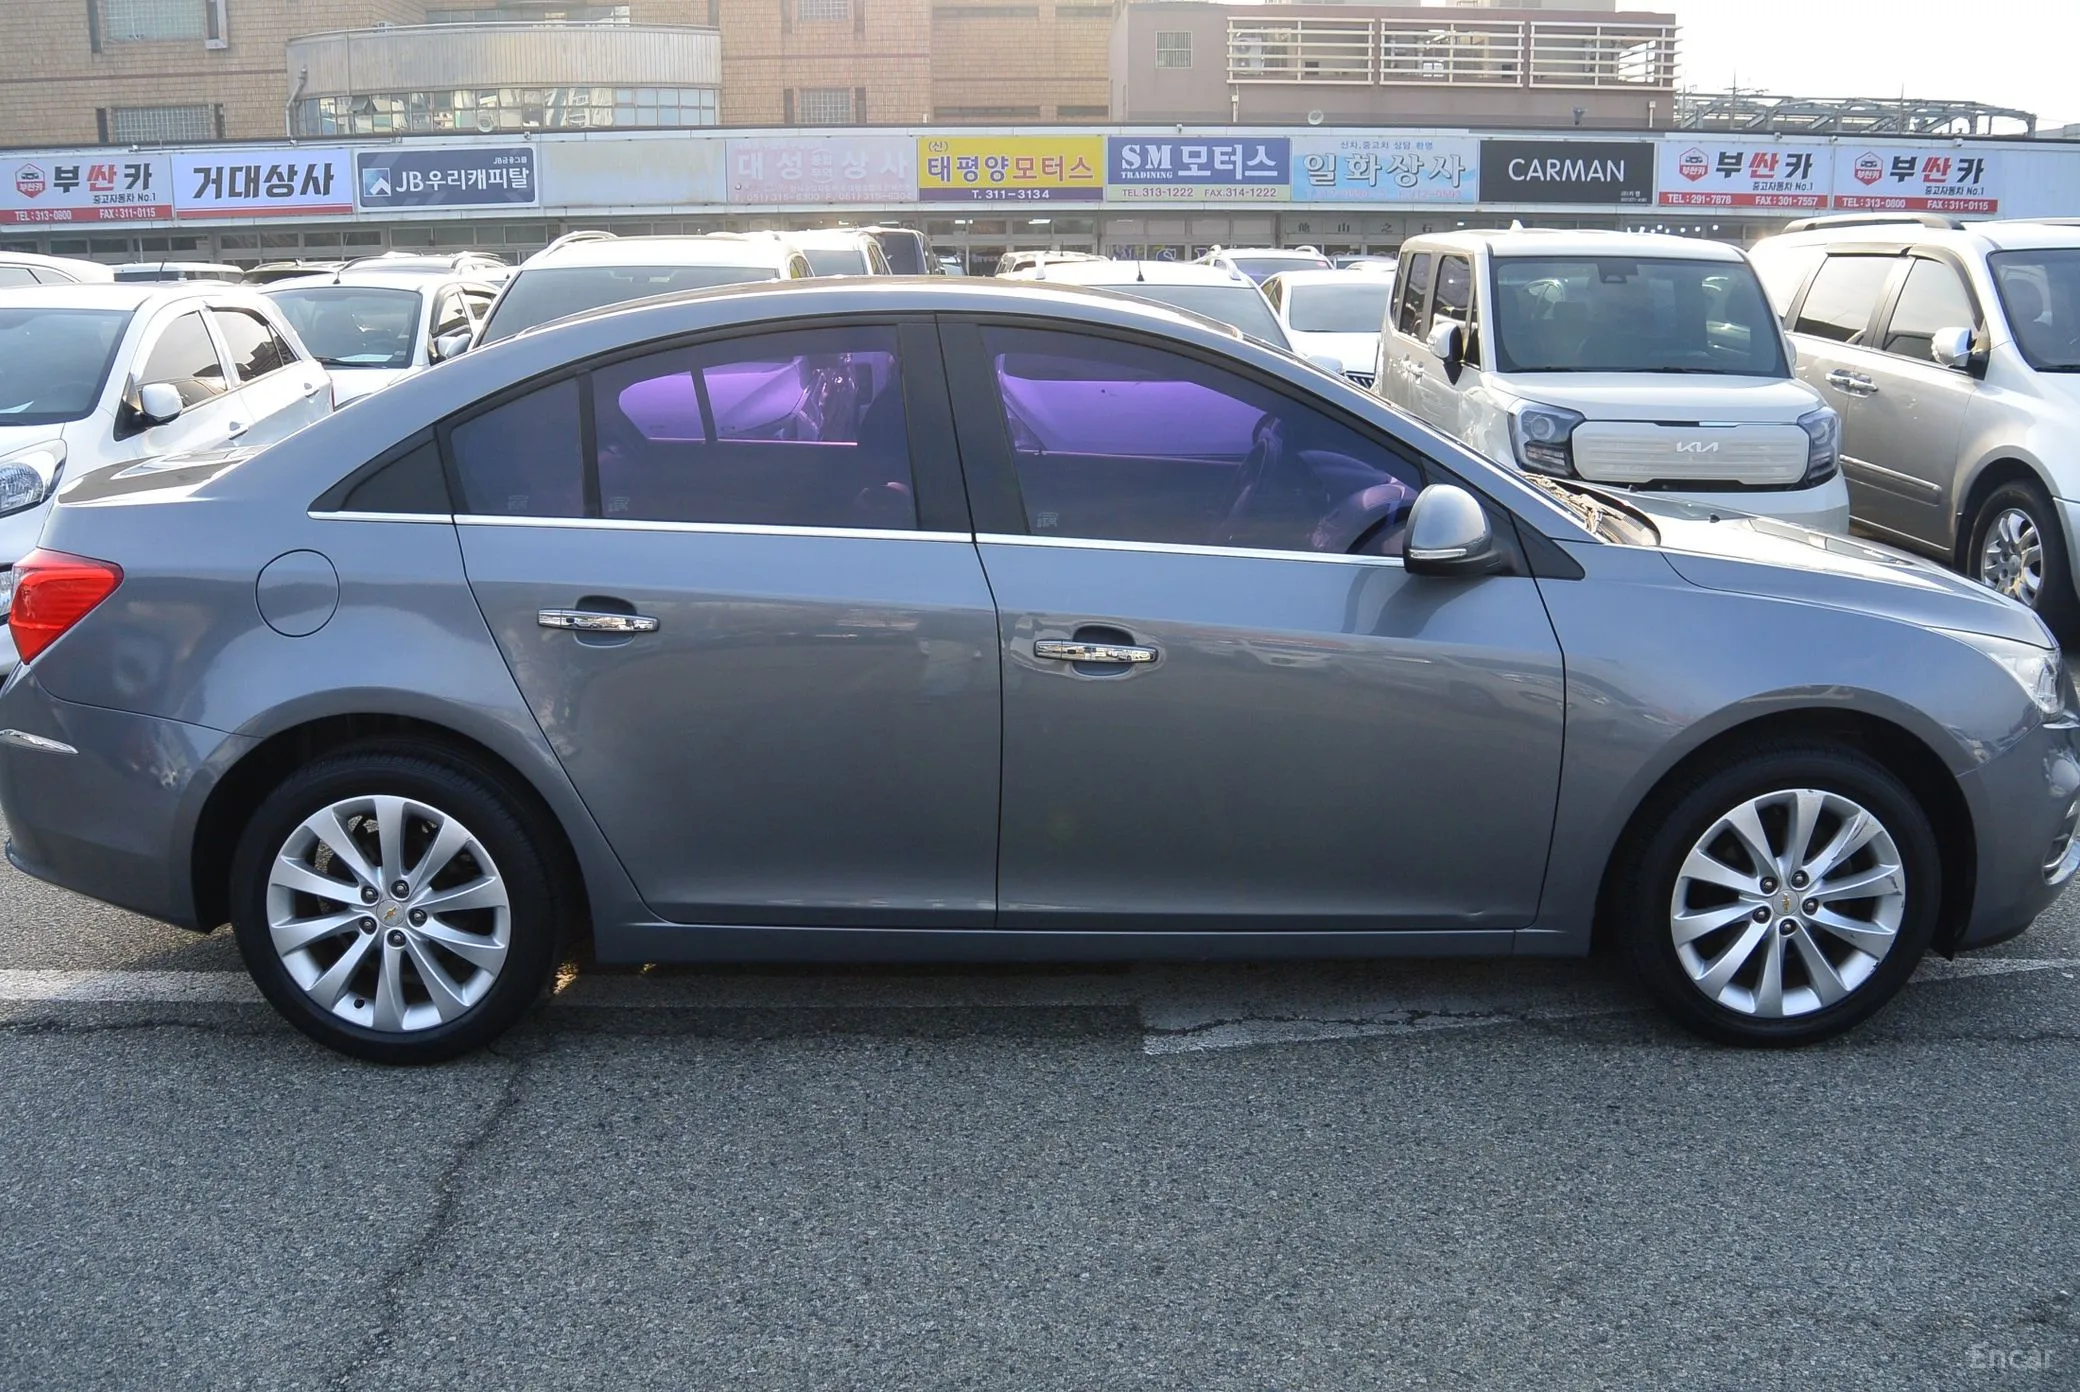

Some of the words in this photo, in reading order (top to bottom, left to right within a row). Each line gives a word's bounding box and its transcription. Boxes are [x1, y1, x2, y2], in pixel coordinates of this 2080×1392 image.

[928, 141, 949, 153] (신)
[927, 155, 1094, 182] 태평양모터스
[1120, 171, 1173, 179] TRADINING
[1121, 144, 1173, 170] SM
[1177, 144, 1278, 180] 모터스
[1303, 152, 1466, 188] 일화상사
[1508, 158, 1625, 182] CARMAN
[1716, 151, 1813, 180] 부싼카
[1889, 156, 1985, 184] 부싼카
[53, 162, 152, 193] 부싼카
[192, 162, 335, 199] 거대상사
[395, 167, 530, 192] JB우리캐피탈
[1795, 182, 1813, 191] No.1
[137, 192, 156, 202] No.1
[1966, 187, 1985, 196] No.1
